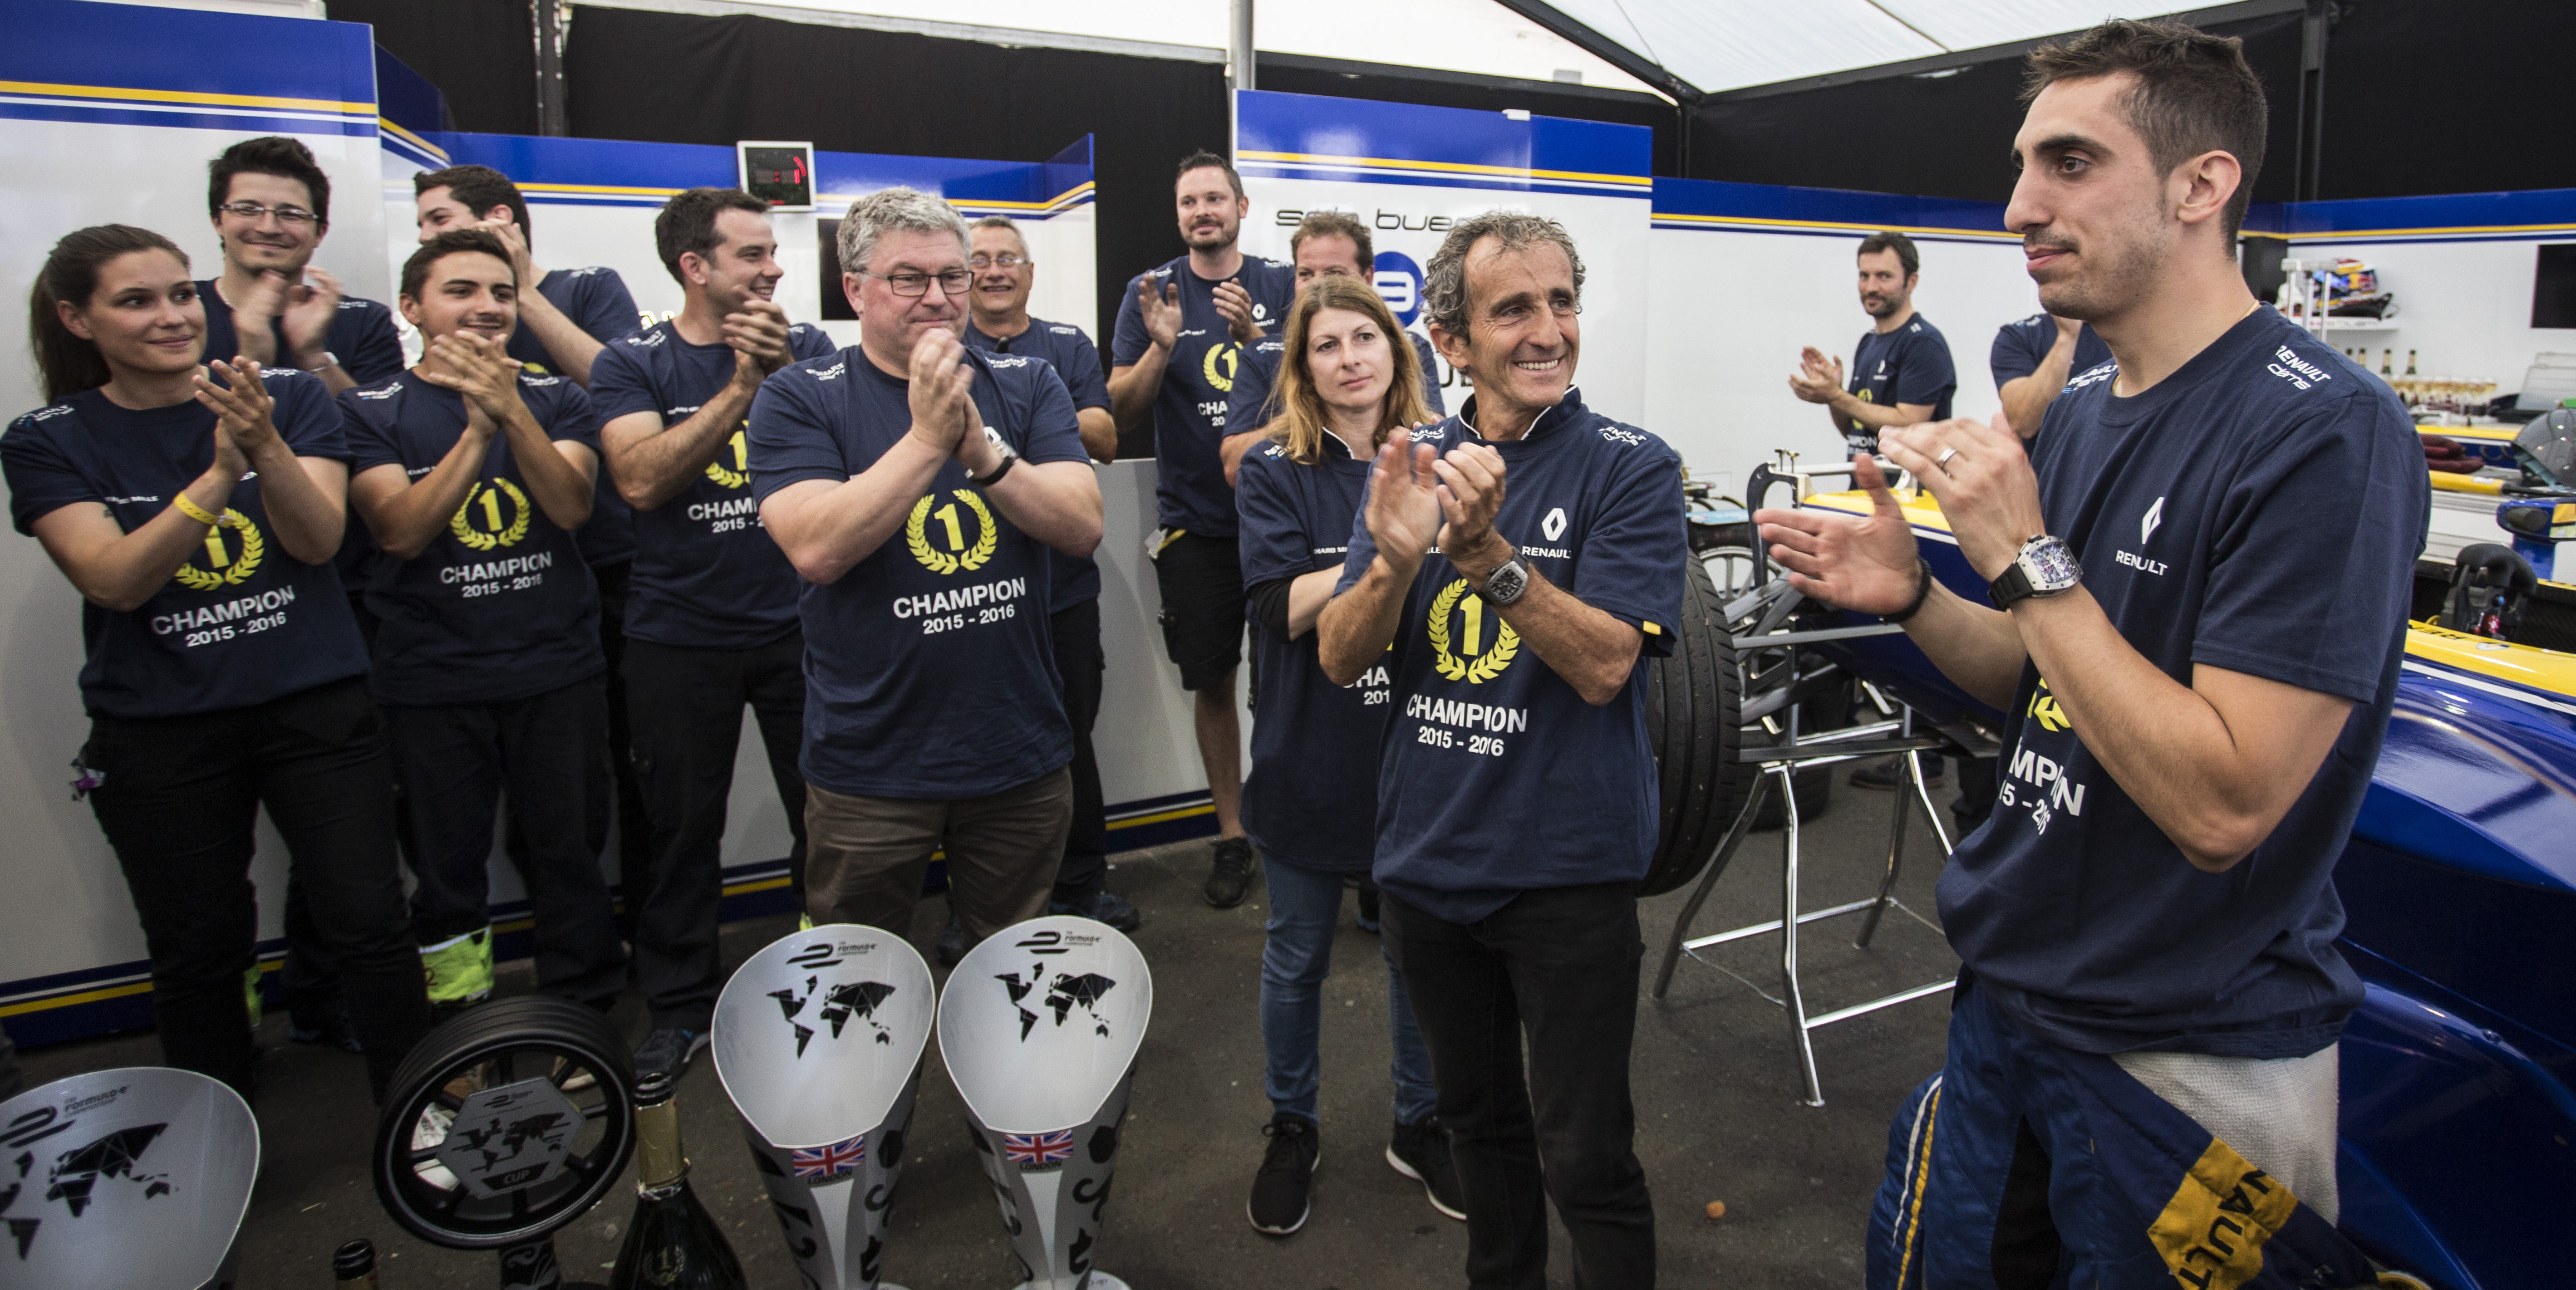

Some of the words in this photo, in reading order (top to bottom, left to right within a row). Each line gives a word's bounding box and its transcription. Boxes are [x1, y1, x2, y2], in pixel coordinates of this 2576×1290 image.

[1375, 208, 1453, 231] bue
[478, 488, 503, 532] 1
[711, 517, 746, 533] 2015
[934, 503, 965, 551] 1
[1522, 546, 1572, 559] RENAUL
[2115, 550, 2168, 576] RENULT
[440, 551, 552, 583] CHAMPION
[461, 581, 500, 598] 2015
[893, 577, 1026, 619] CHAMPION
[151, 585, 296, 635] CHAMPION
[922, 614, 964, 635] 2015
[979, 604, 1015, 624] 2016
[185, 626, 236, 648] 2015
[247, 611, 287, 634] 2016
[1406, 693, 1527, 733] CHAMPION
[1418, 726, 1453, 749] 2015
[505, 1170, 529, 1184] CUP
[808, 1168, 853, 1185] LONDON
